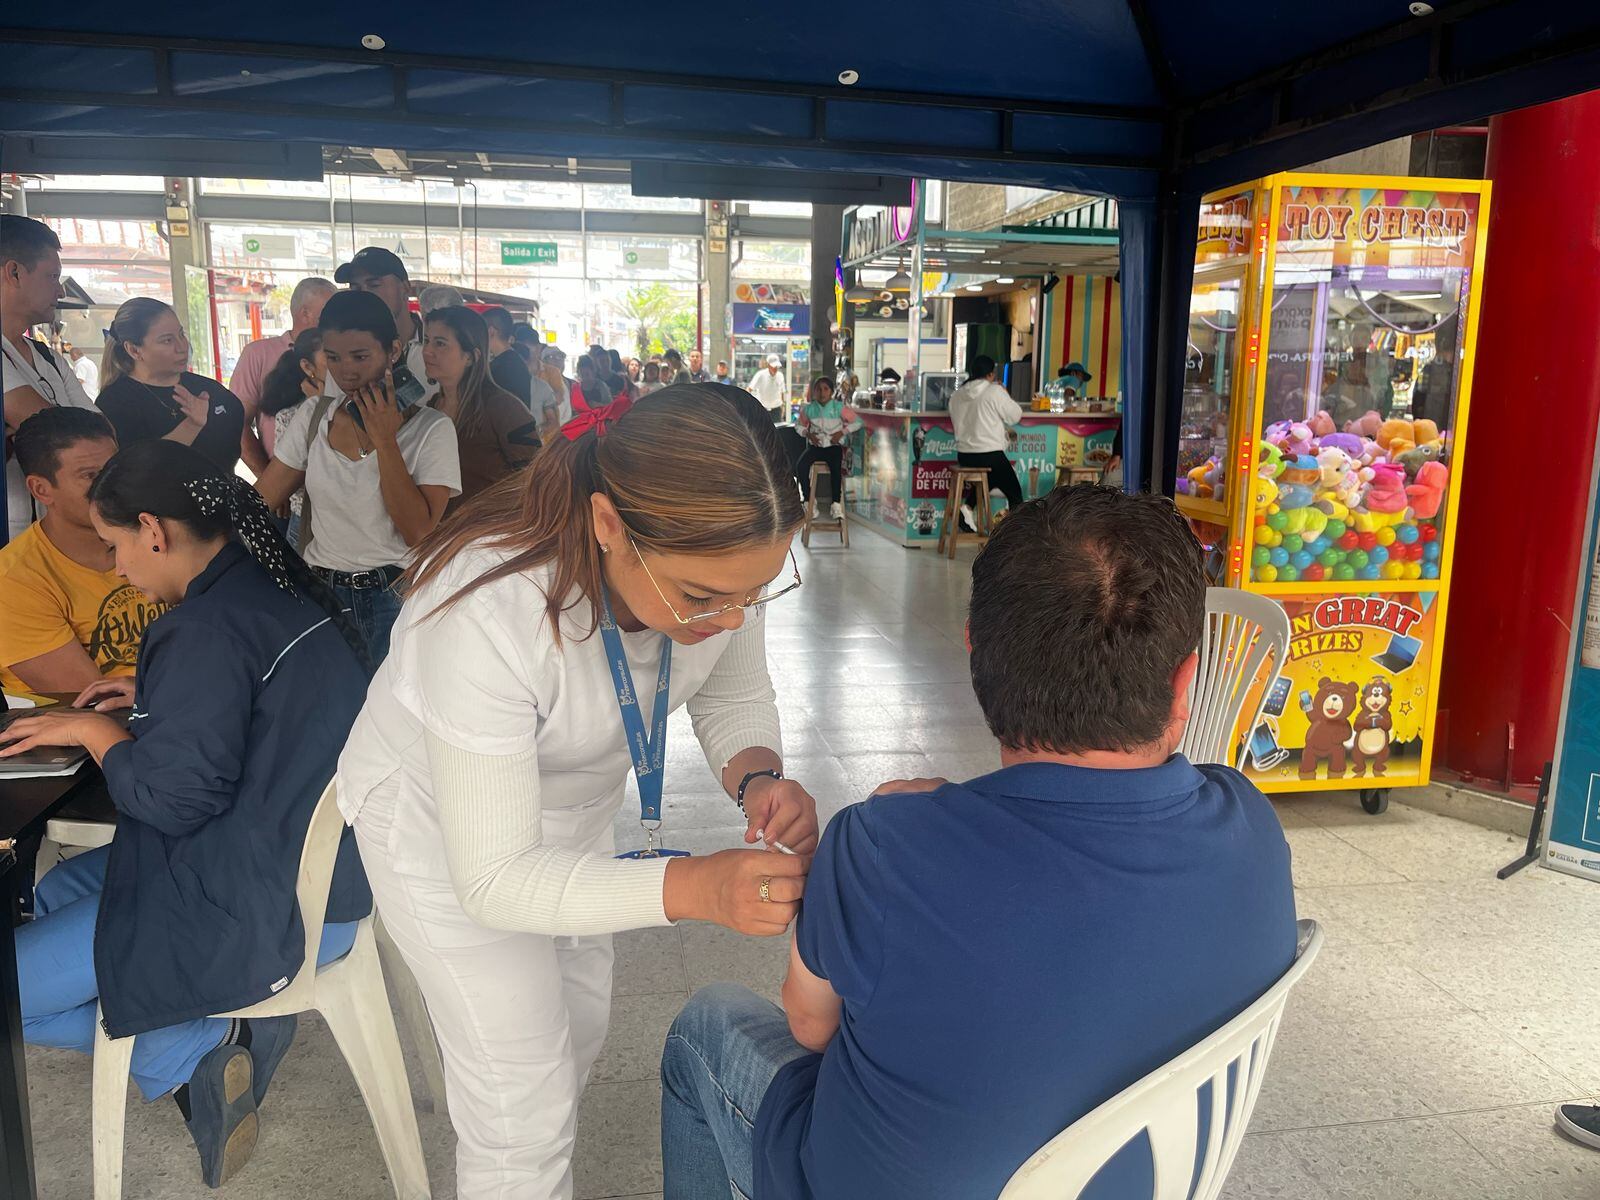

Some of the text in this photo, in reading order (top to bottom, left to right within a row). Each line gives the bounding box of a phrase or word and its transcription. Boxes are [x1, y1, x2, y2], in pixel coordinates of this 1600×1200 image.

[1285, 204, 1469, 255] TOY CHEST
[503, 247, 530, 257] Salida
[537, 248, 556, 258] Exit
[1021, 443, 1046, 453] COCO
[916, 467, 953, 479] Ensala
[916, 480, 930, 490] DE
[1315, 597, 1421, 637] GREAT
[1285, 630, 1363, 663] RIZES
